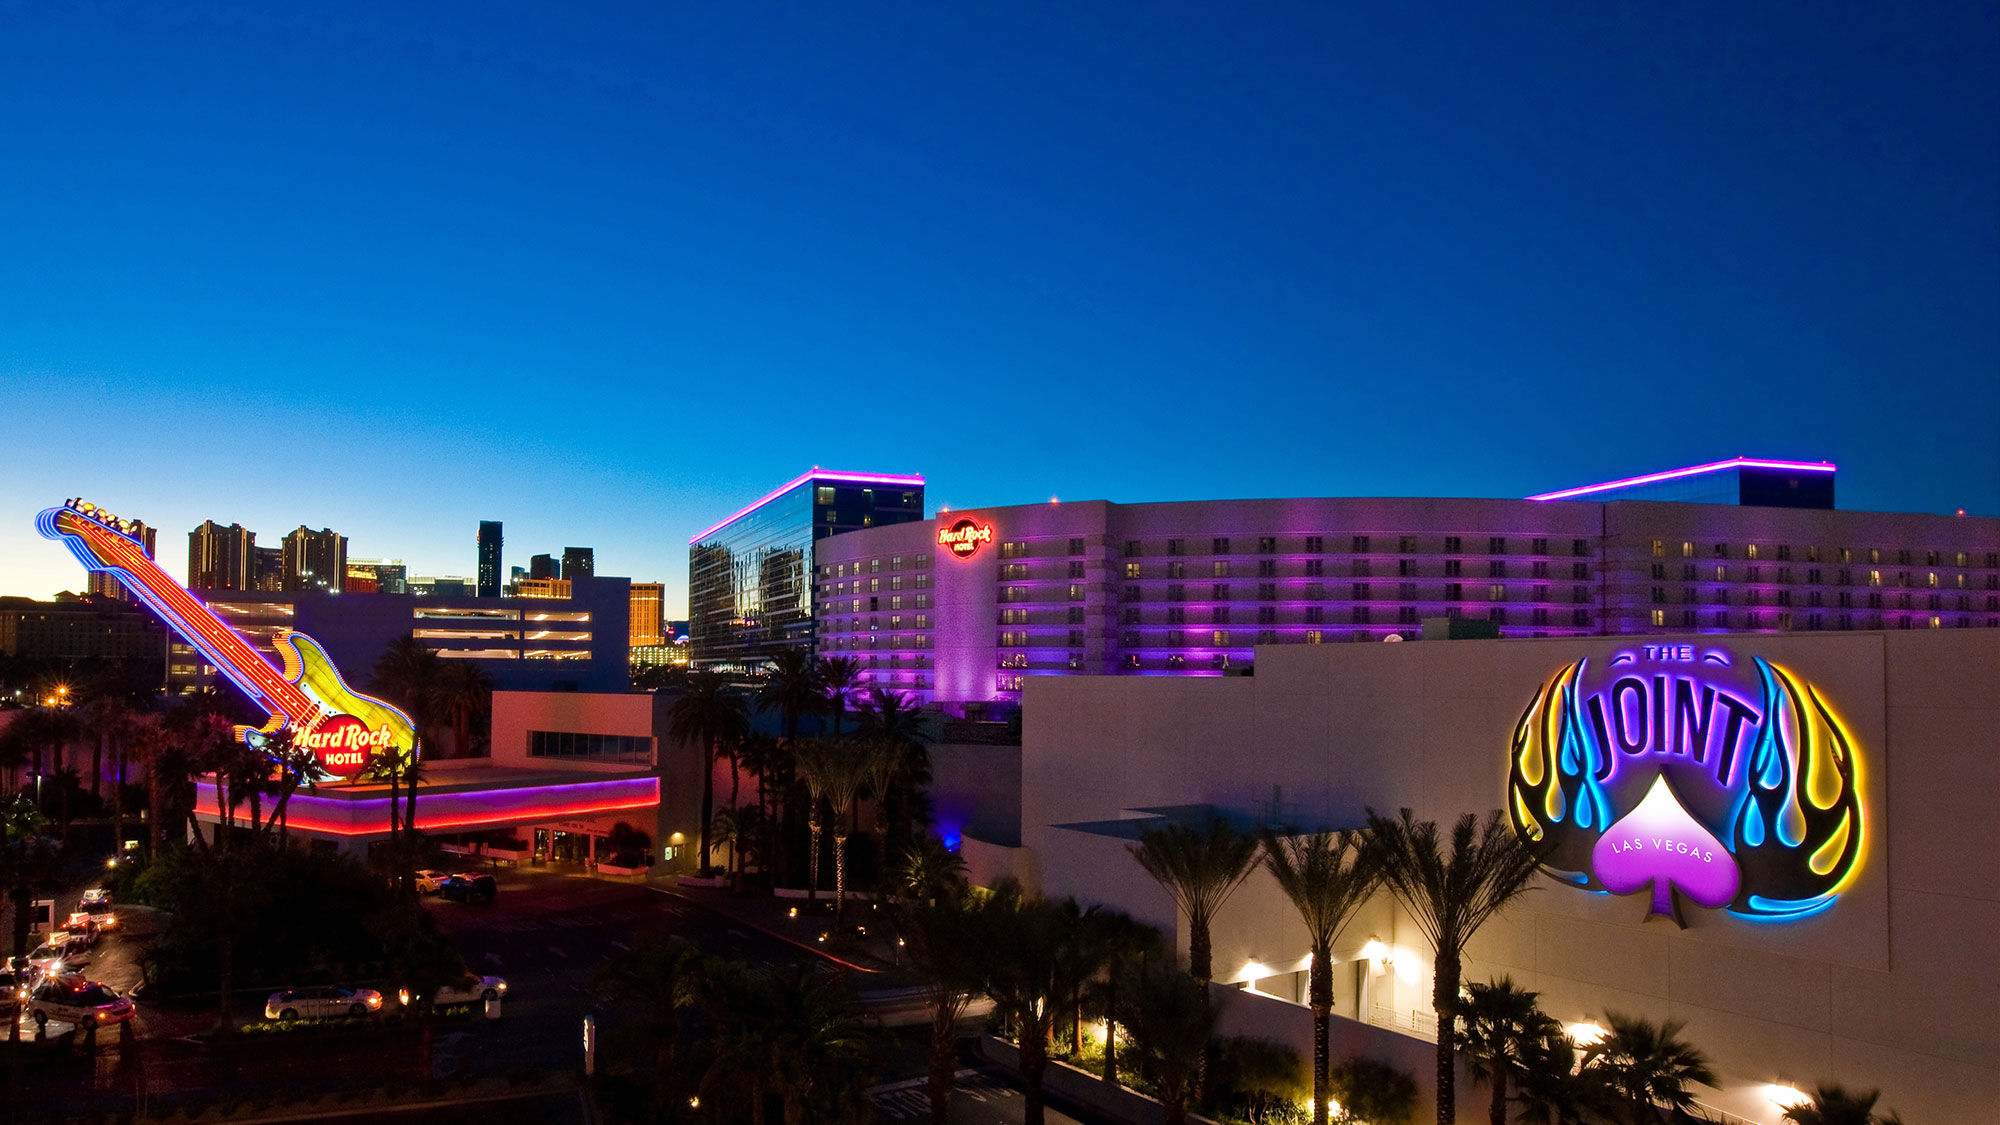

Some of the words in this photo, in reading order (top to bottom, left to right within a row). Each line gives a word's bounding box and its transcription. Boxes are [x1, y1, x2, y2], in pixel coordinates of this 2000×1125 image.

[939, 528, 965, 543] Hard
[964, 525, 991, 543] Rock
[953, 543, 974, 551] HOTEL
[1641, 645, 1692, 661] THE
[294, 725, 345, 748] Hard
[344, 723, 392, 751] Rock
[1586, 675, 1760, 787] JOINT
[325, 752, 364, 765] HOTEL
[1611, 838, 1643, 854] LAS
[1652, 838, 1713, 864] VEGAS
